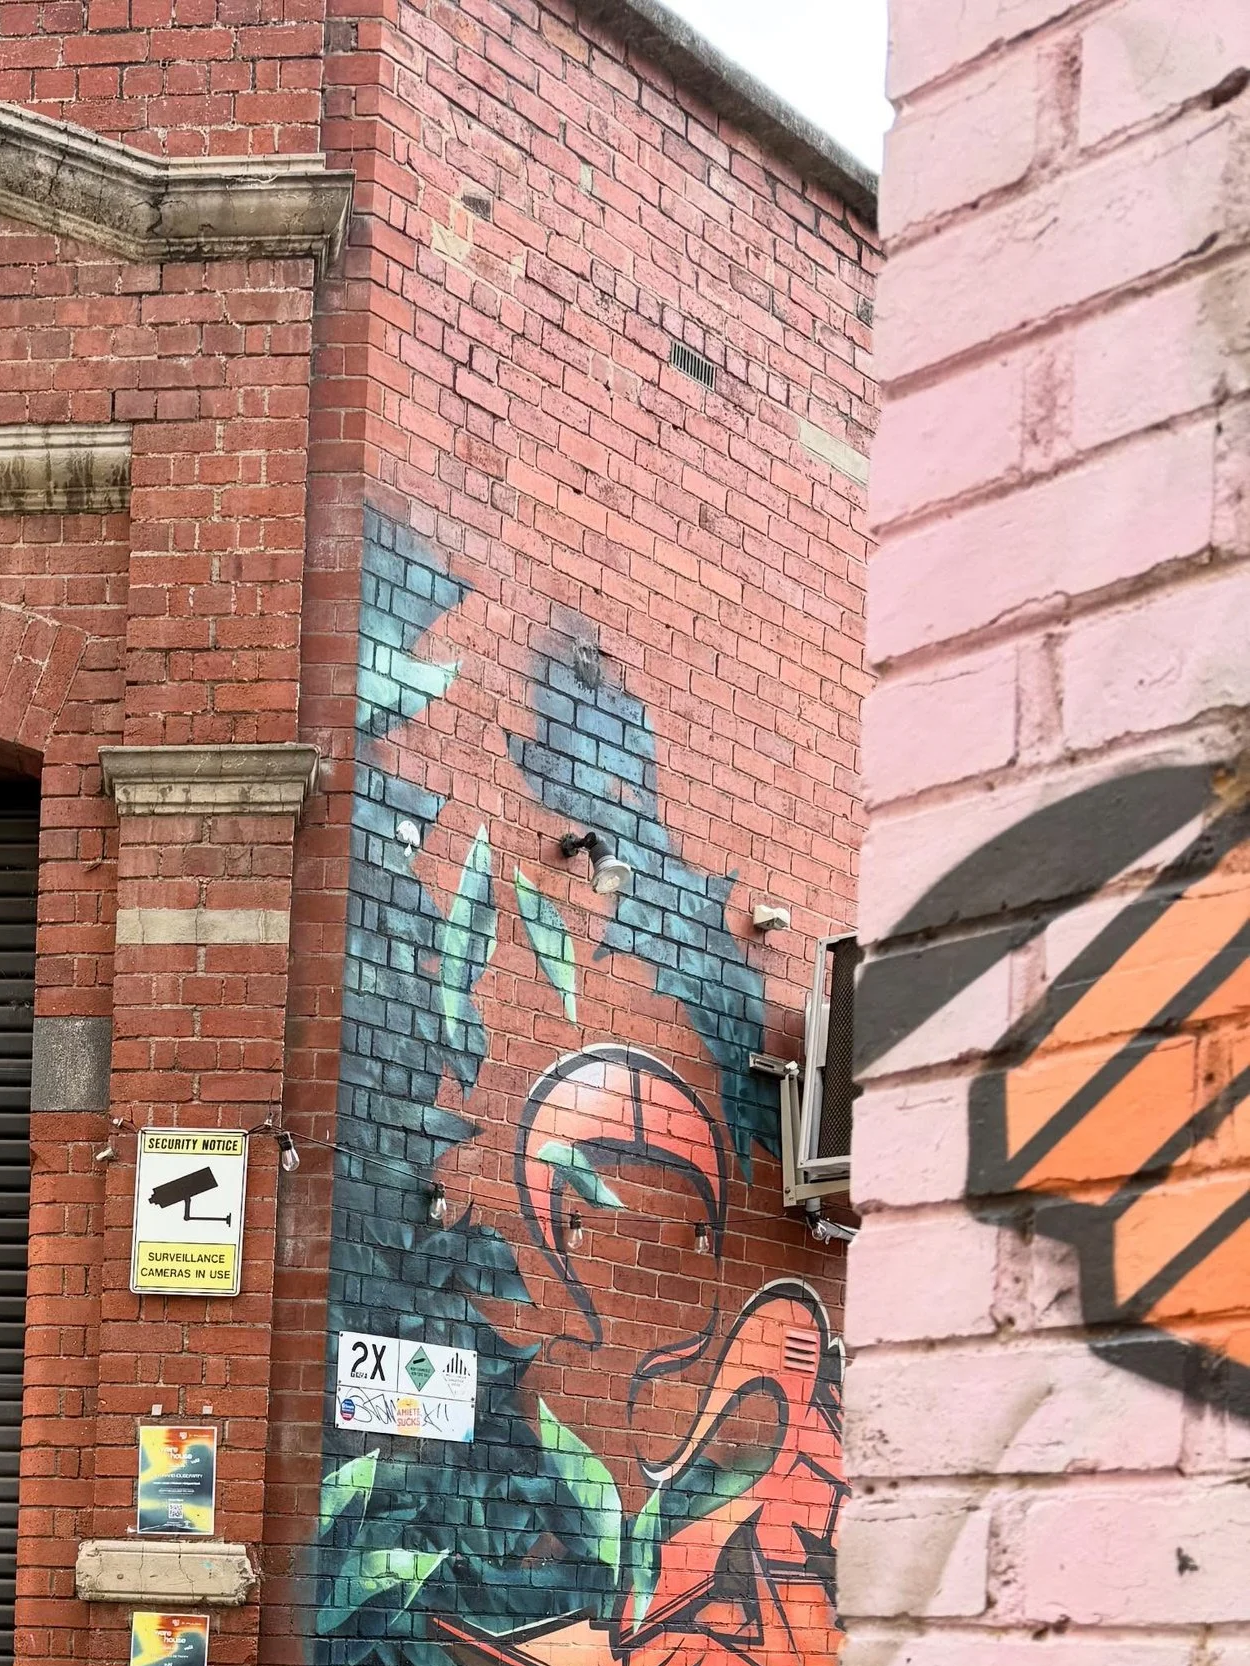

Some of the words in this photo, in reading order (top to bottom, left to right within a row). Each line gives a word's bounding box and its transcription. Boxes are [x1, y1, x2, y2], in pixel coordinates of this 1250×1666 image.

[148, 1138, 198, 1150] SECURITY
[202, 1139, 239, 1151] NOTICE
[148, 1252, 226, 1264] SURVEILLANCE
[140, 1267, 191, 1278] CAMERAS
[195, 1269, 206, 1279] IN
[209, 1269, 231, 1279] USE
[350, 1341, 387, 1381] 2X
[397, 1417, 421, 1427] SUCKS
